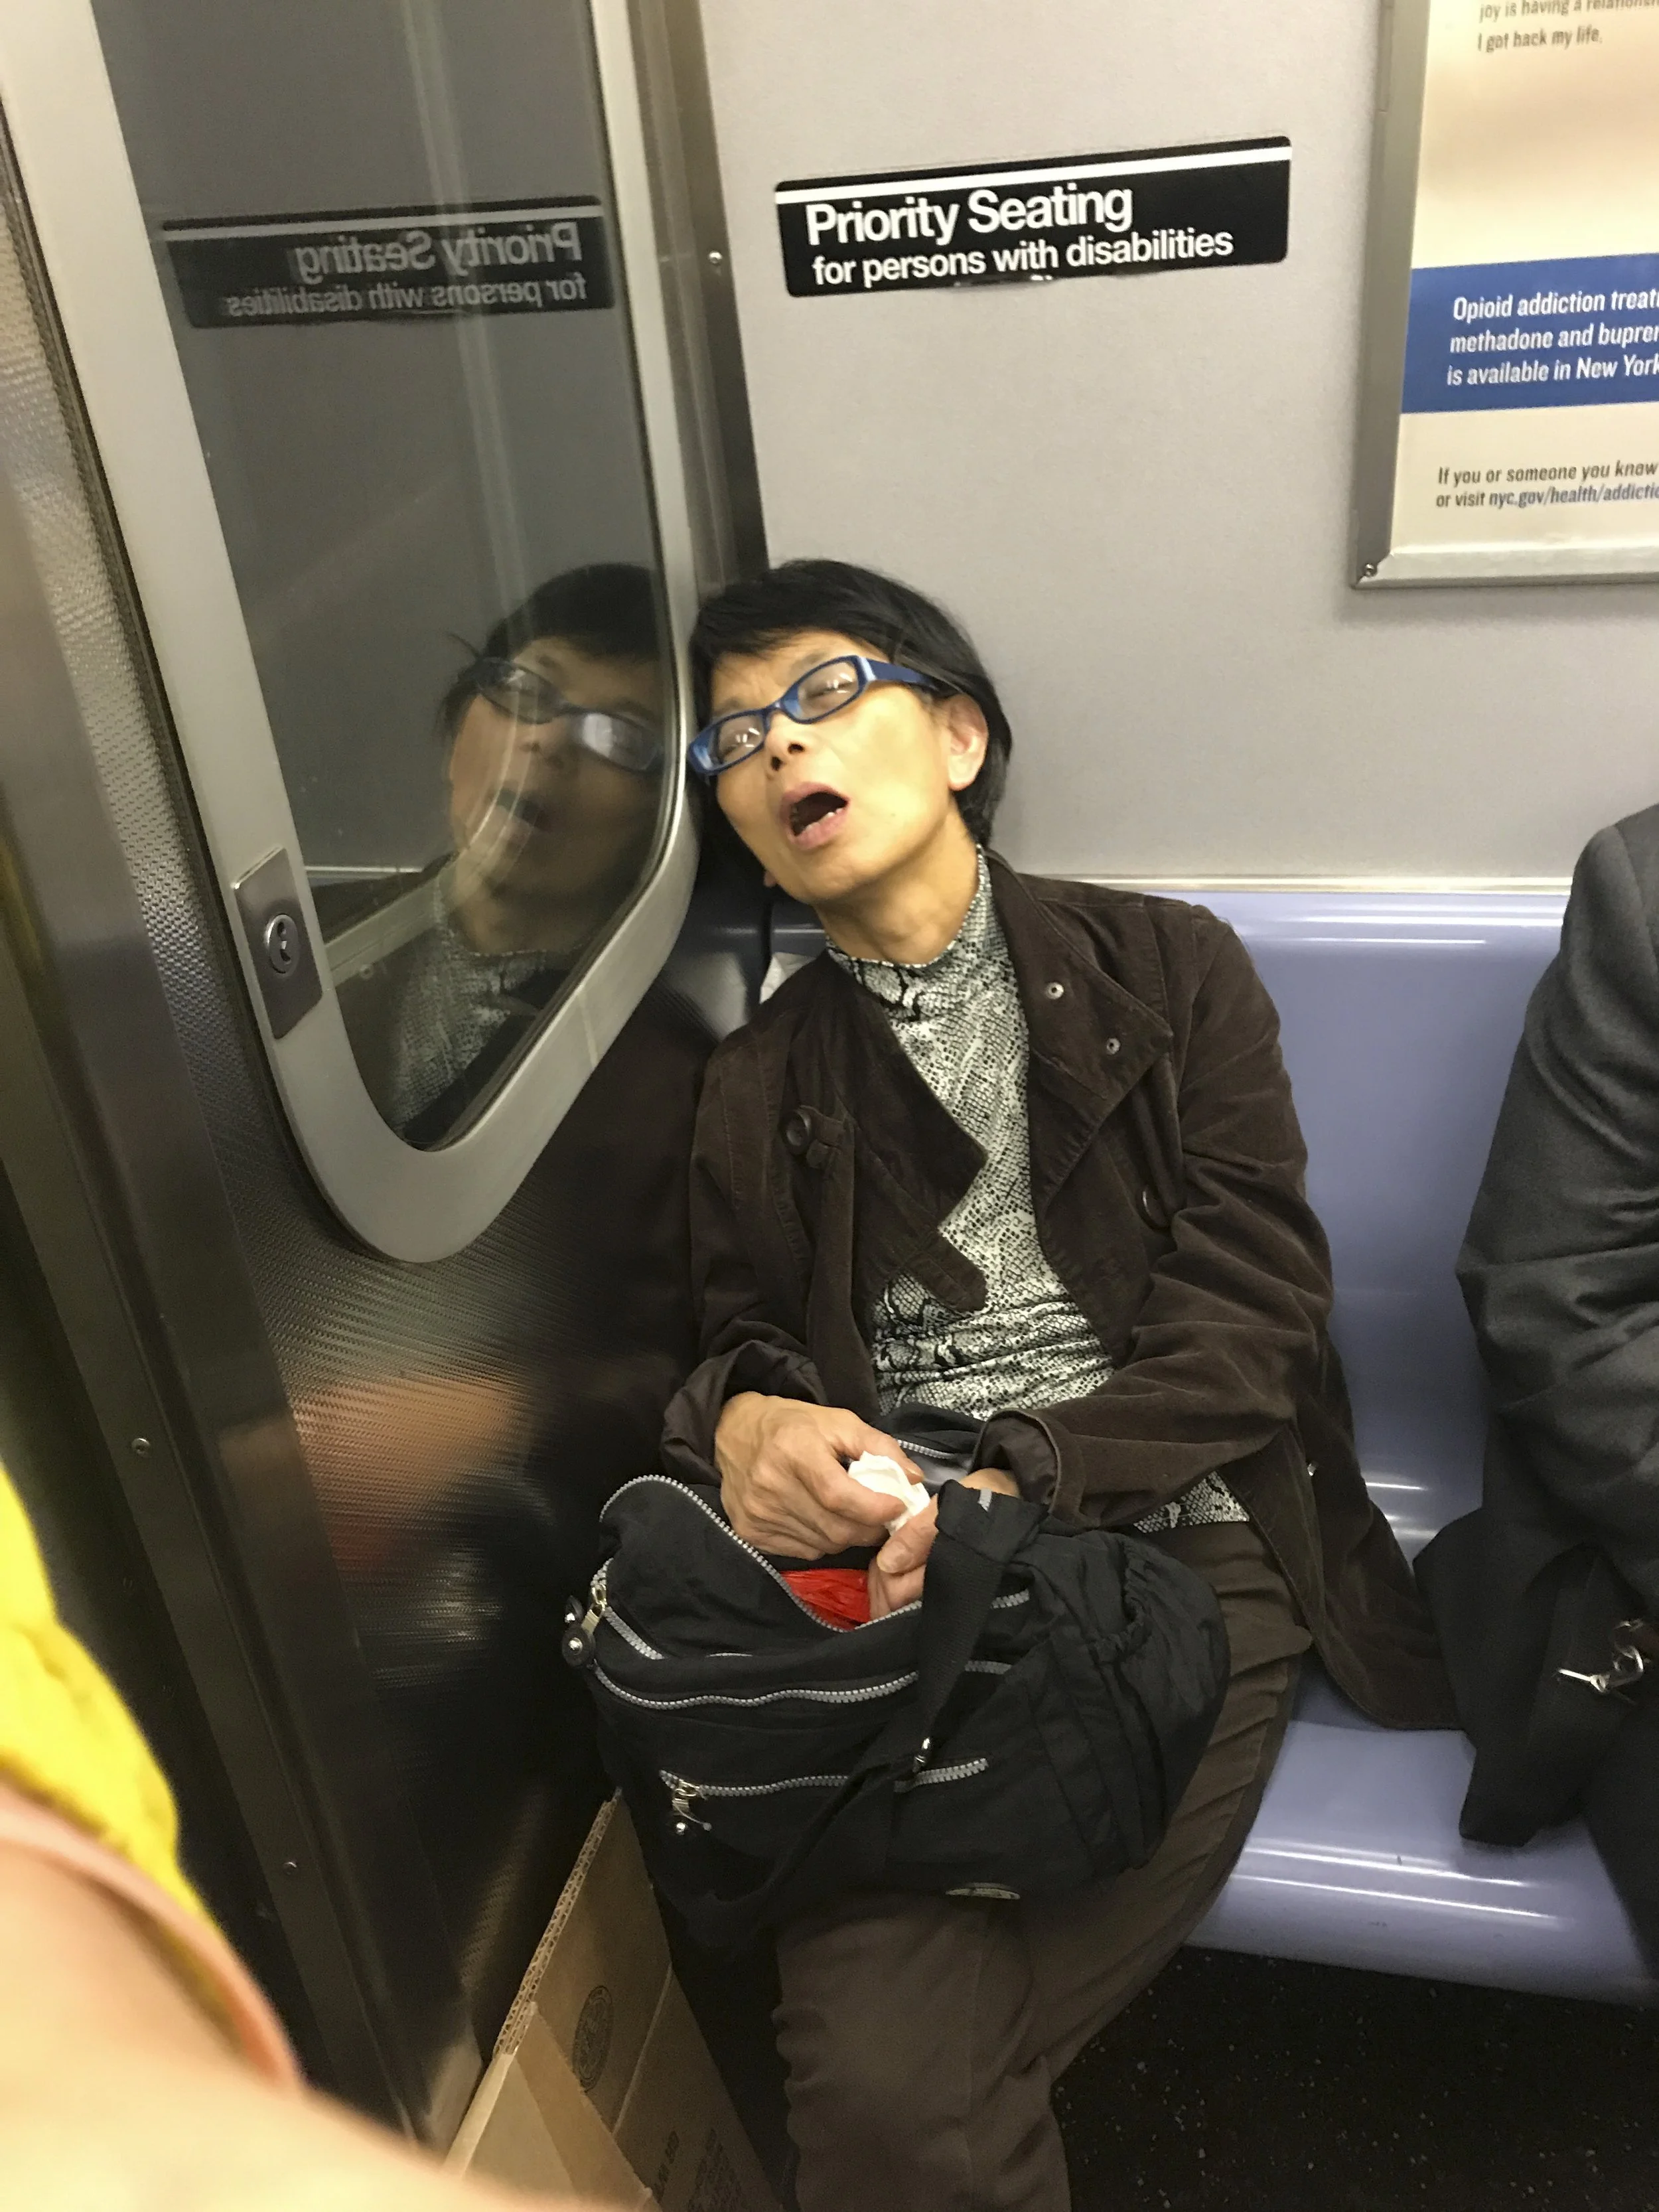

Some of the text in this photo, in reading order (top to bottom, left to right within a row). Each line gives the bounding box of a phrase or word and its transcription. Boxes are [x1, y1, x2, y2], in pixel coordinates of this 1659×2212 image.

[1479, 3, 1501, 23] joy
[1505, 2, 1517, 18] is
[1522, 0, 1570, 16] having
[1477, 24, 1603, 53] I got back my life.
[805, 183, 1132, 246] Priority Seating
[812, 230, 1234, 287] for persons with disabilities
[1453, 293, 1513, 324] Opioid
[1517, 290, 1605, 317] addiction
[1450, 328, 1553, 353] methadone
[1557, 323, 1595, 347] and
[1447, 365, 1463, 386] is
[1467, 360, 1550, 384] available
[1553, 359, 1571, 380] in
[1575, 356, 1618, 379] New
[1439, 459, 1659, 488] If you or someone you know
[1436, 494, 1451, 507] or
[1455, 489, 1485, 507] visit
